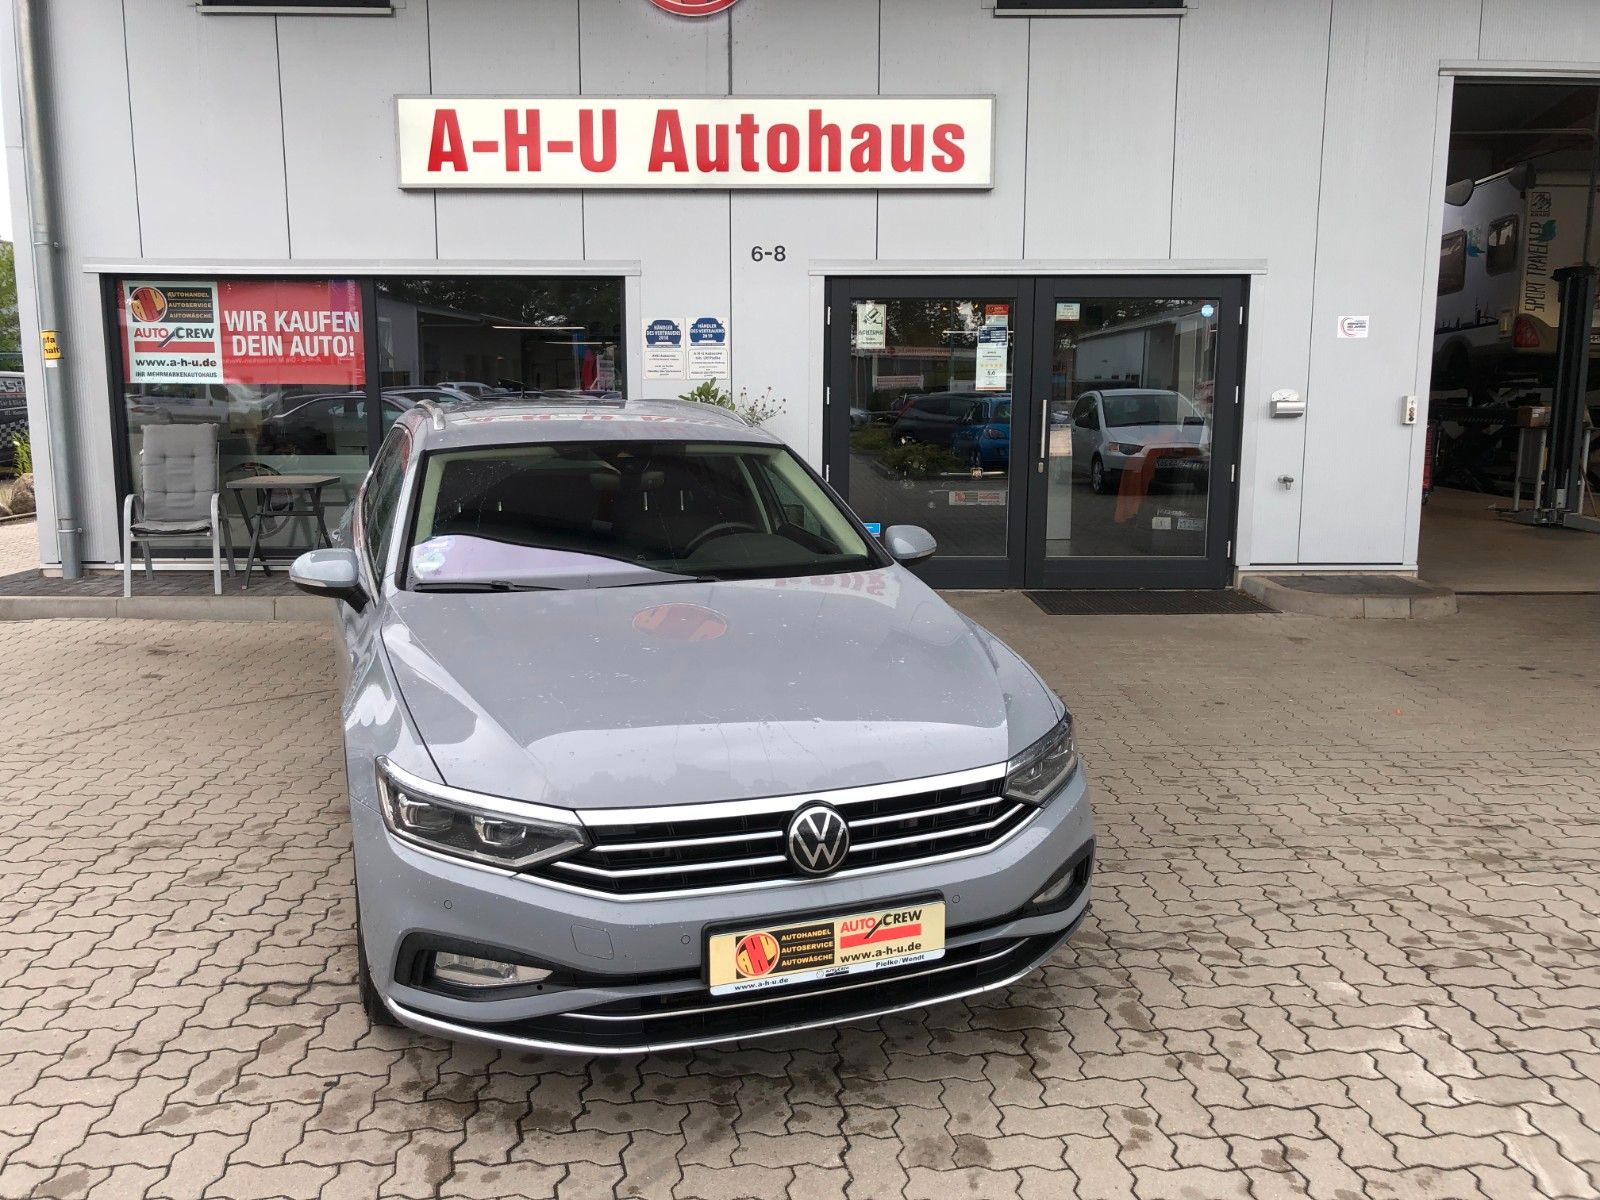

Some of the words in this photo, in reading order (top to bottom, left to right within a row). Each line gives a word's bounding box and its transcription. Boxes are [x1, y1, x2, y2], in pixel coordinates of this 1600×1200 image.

[427, 109, 617, 172] A-H-U
[648, 109, 965, 172] Autohaus
[751, 245, 786, 262] 6-8
[224, 310, 267, 332] WIR
[274, 310, 360, 332] KAUFEN
[232, 335, 283, 357] DEIN
[290, 335, 355, 357] AUTO!
[135, 358, 217, 367] www.a-h-u.de
[781, 928, 832, 941] AUTOHANDEL
[781, 941, 833, 954] AUTOSERVICE
[840, 942, 922, 963] www.a-h-u.de
[781, 953, 834, 967] AUTOWÄSCHE
[734, 977, 789, 991] www.a-h-u.de
